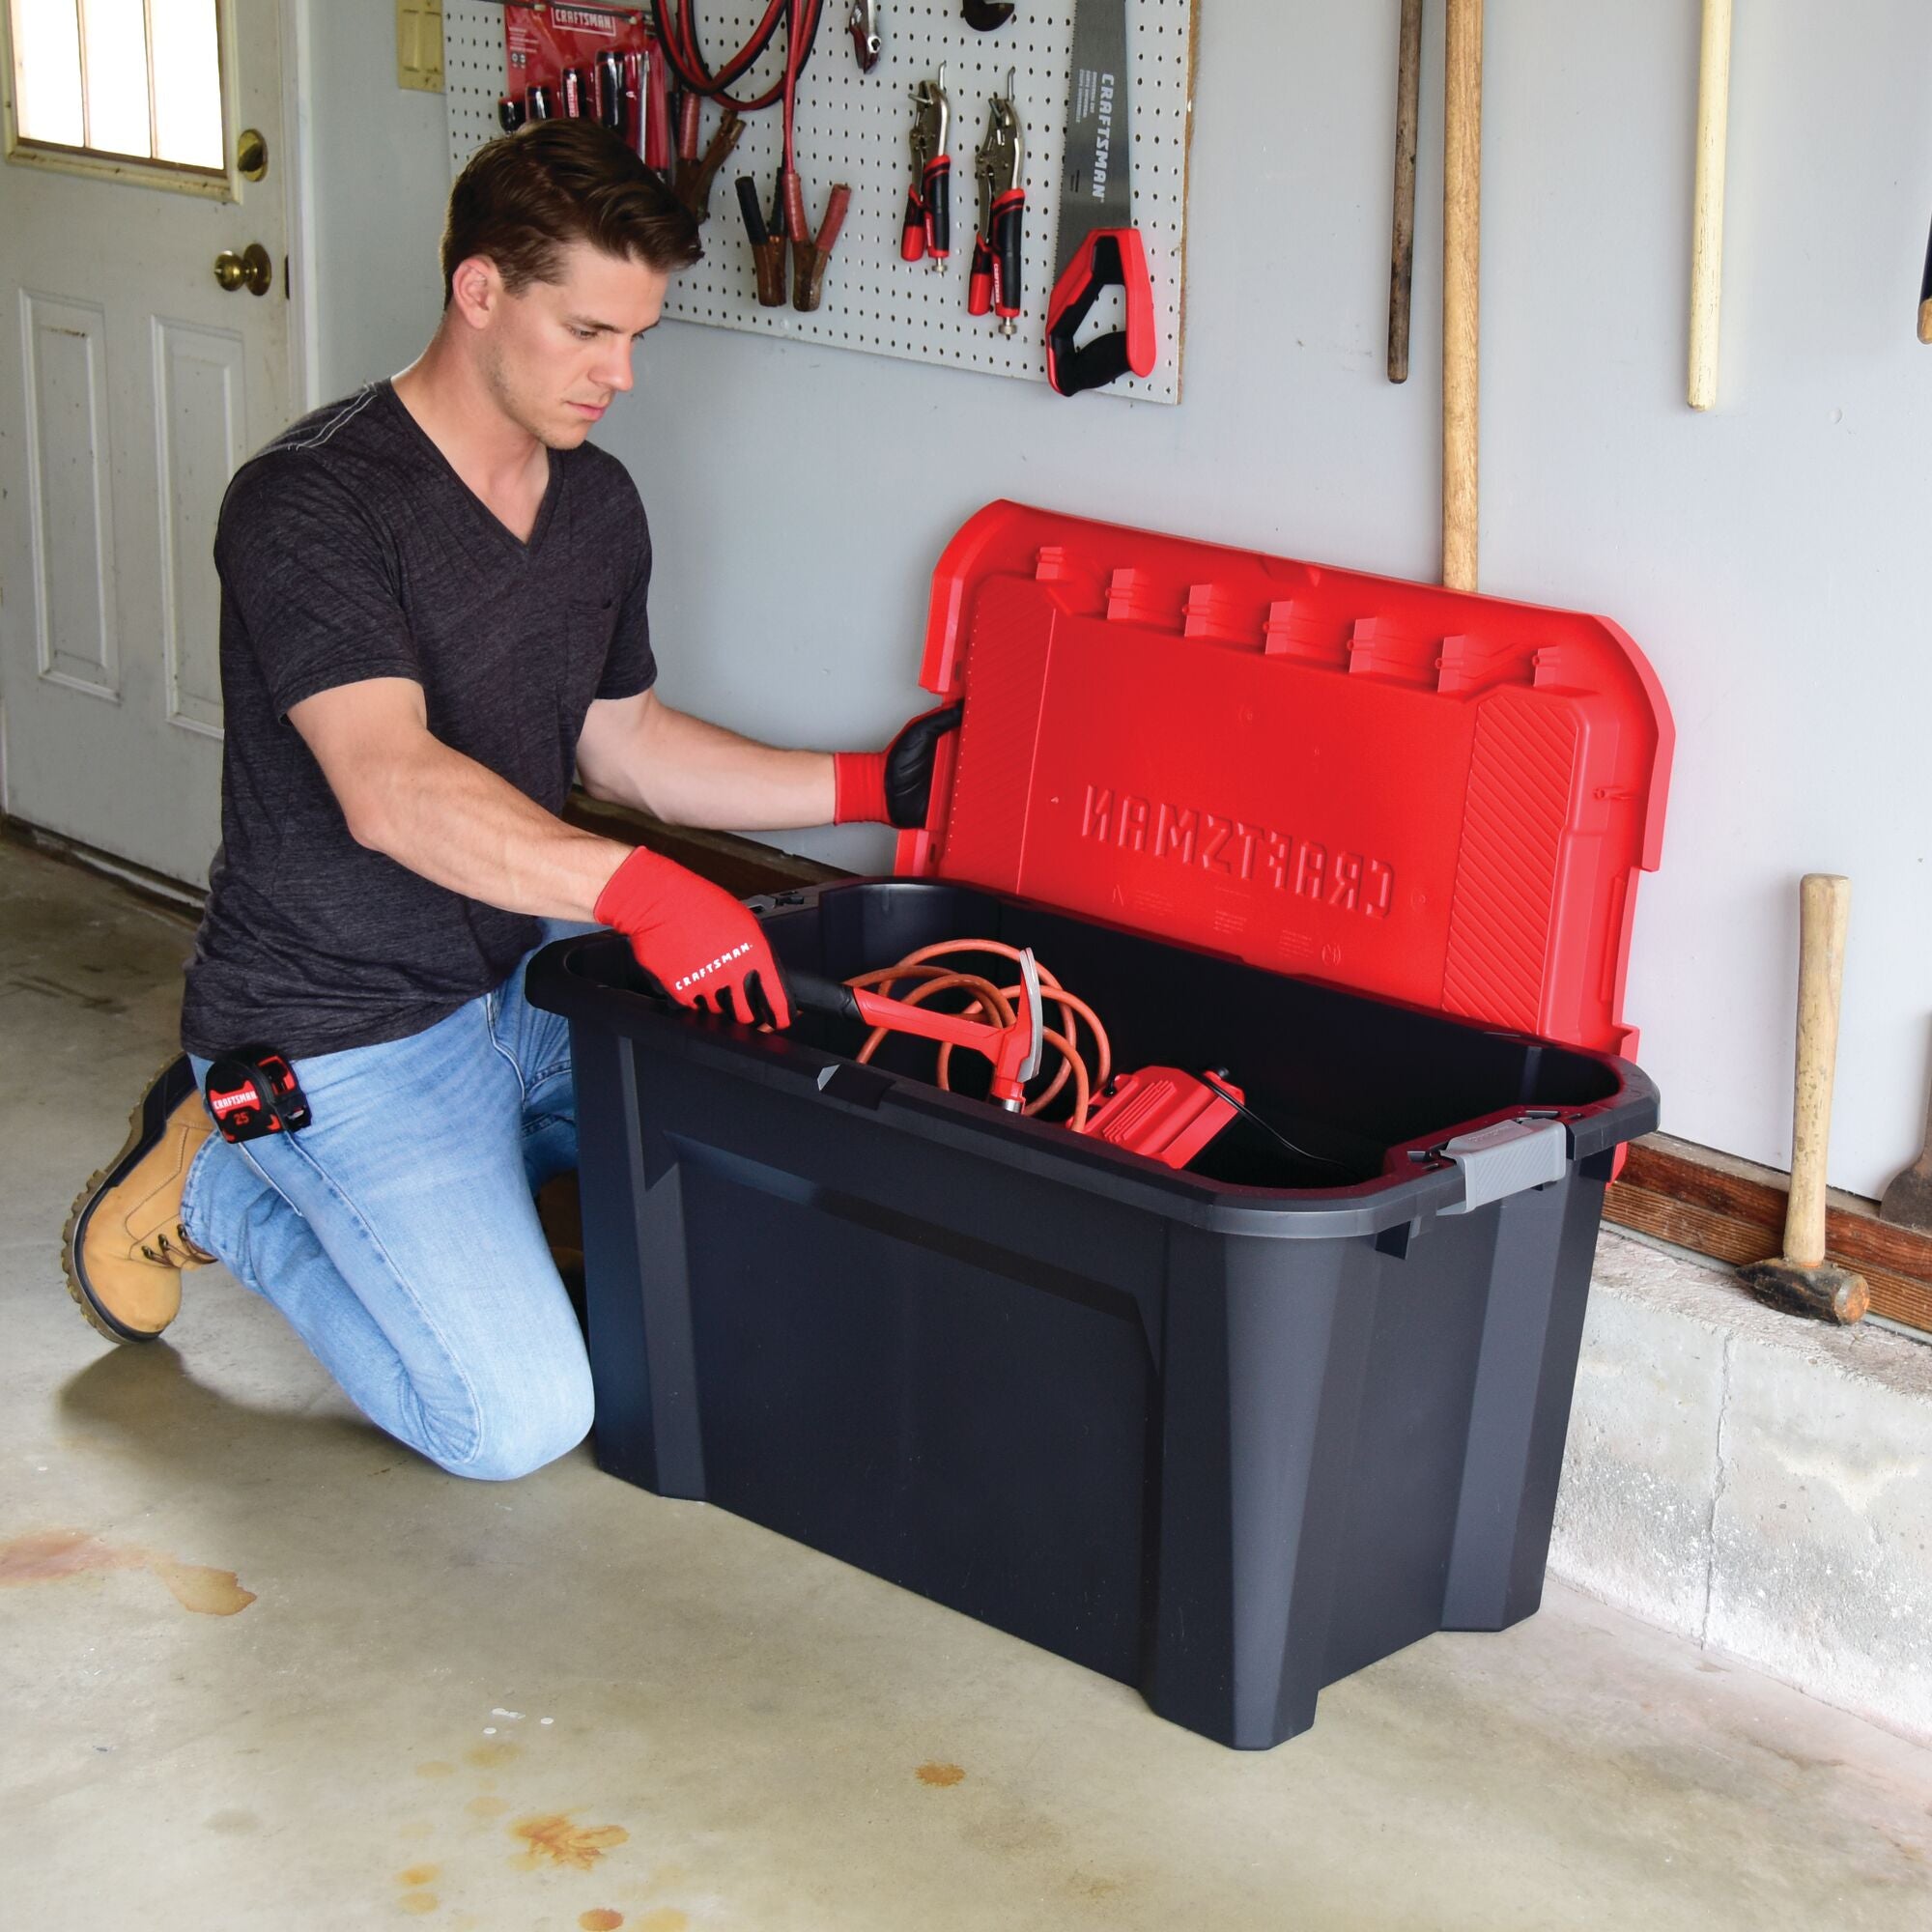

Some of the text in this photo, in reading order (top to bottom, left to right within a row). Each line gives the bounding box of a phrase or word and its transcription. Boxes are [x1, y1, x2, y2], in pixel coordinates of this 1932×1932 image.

[555, 9, 611, 30] CRAFTSMAN
[1093, 73, 1114, 199] CRAFTSMAN
[675, 943, 750, 990] CRAFTSMAN
[213, 1091, 258, 1110] CRAFTSMAN
[234, 1112, 249, 1125] 25
